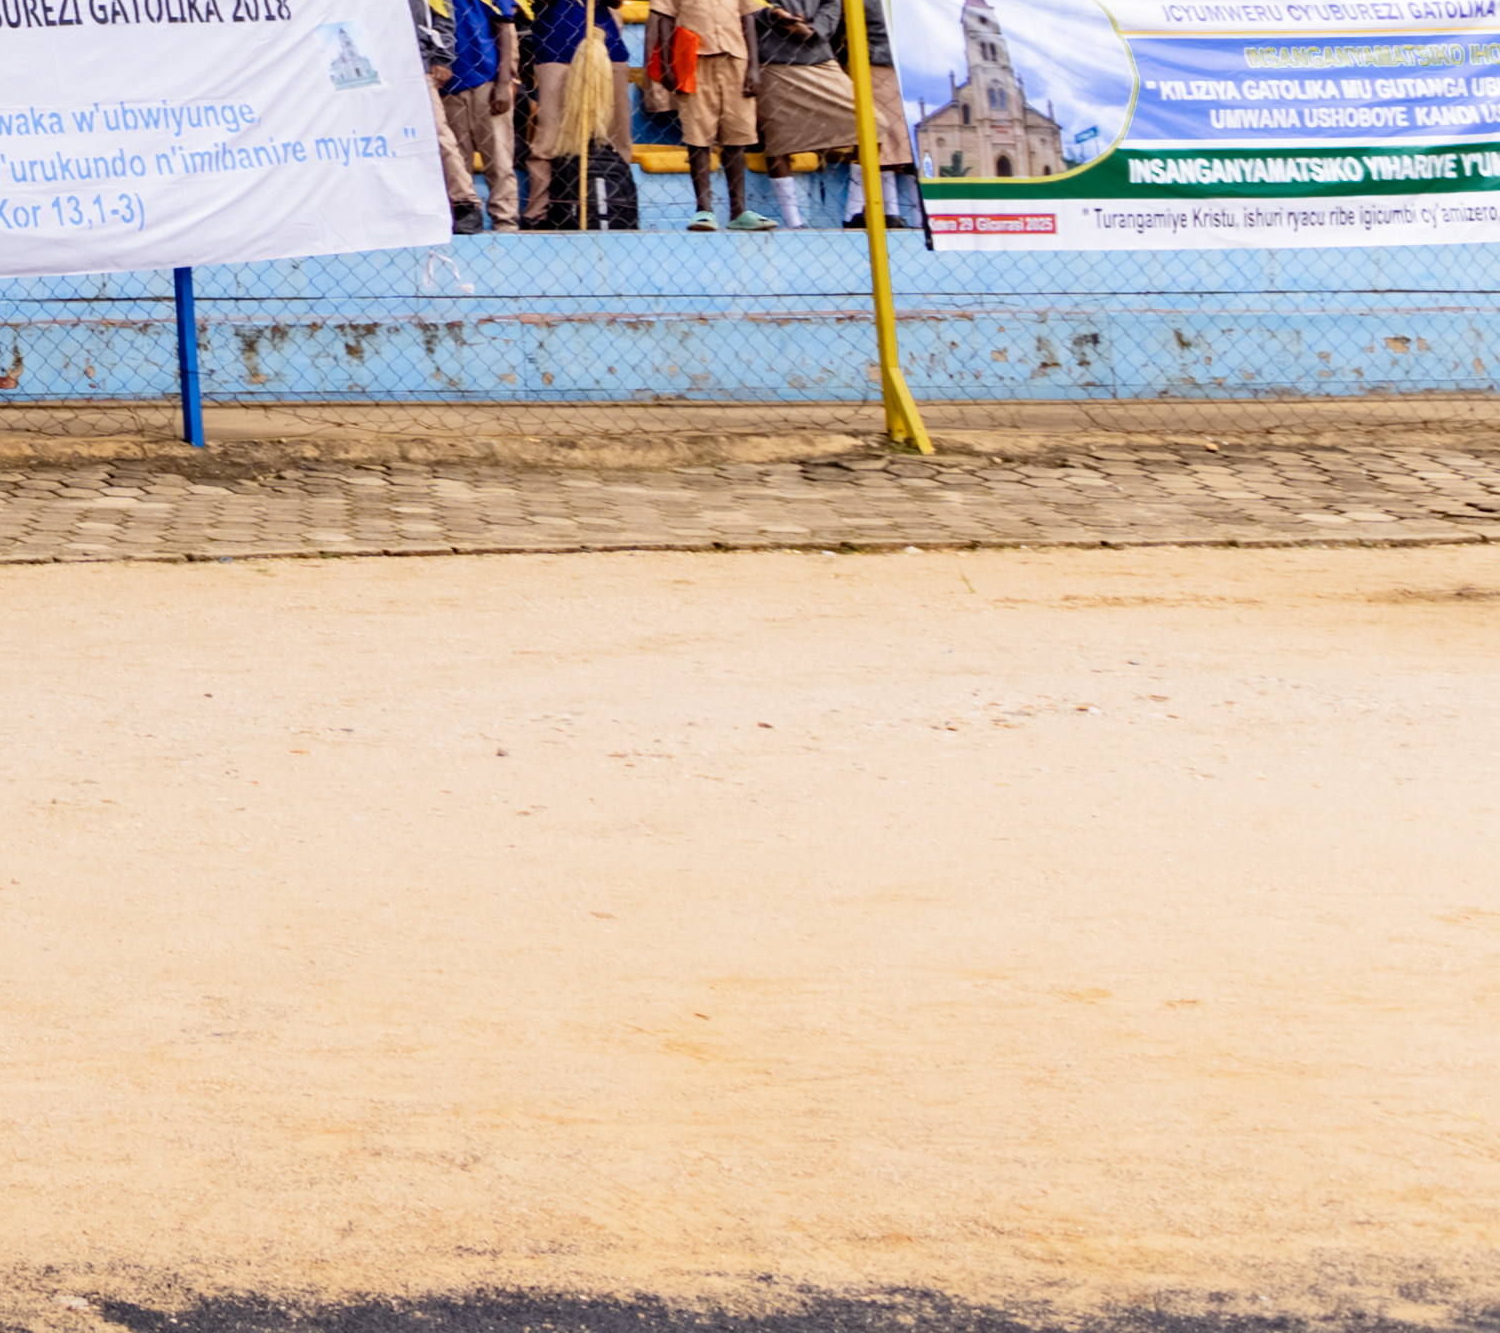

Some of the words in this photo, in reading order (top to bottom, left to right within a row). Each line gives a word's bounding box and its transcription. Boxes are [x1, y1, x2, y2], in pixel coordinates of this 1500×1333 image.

[1161, 4, 1284, 23] ICYUMWERU
[1287, 2, 1405, 21] CY'UBUREZI
[1244, 44, 1465, 68] INSANGANYAMATSIKO
[1242, 80, 1340, 101] GATOLIKA
[1341, 80, 1372, 100] MU
[1375, 78, 1469, 99] GUTANGA
[1210, 108, 1301, 129] UMWANA
[1304, 106, 1409, 128] USHOBOYE
[1414, 104, 1481, 126] KANDI
[155, 137, 307, 176] n'imibanire
[315, 129, 397, 167] myiza.
[1128, 156, 1362, 185] INSANGANYAMATSIKO
[1363, 153, 1458, 182] YIHARIYE
[51, 192, 145, 231] 13,1-3)
[1093, 207, 1188, 233] Turangamiye
[1330, 206, 1355, 225] ribe
[1360, 204, 1418, 231] igicumbi
